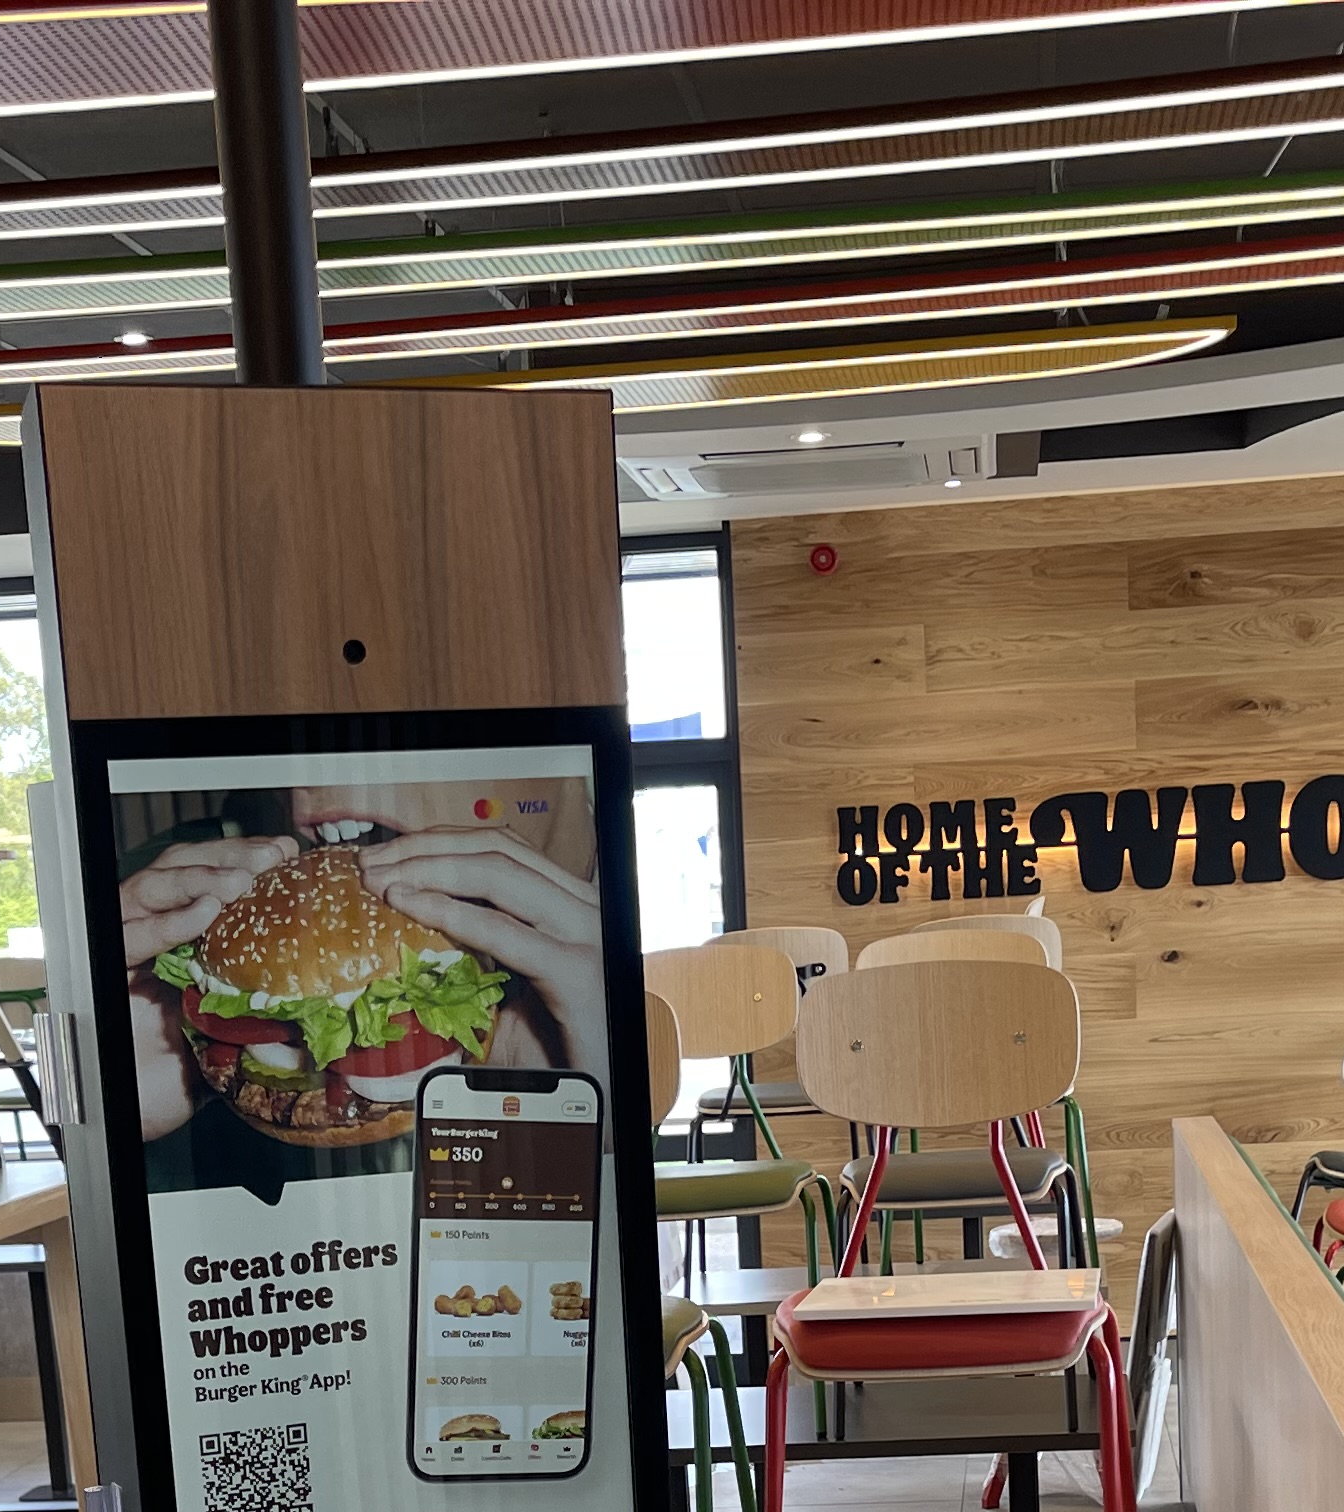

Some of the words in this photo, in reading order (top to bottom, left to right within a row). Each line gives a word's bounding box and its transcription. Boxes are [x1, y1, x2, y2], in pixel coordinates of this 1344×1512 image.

[516, 799, 549, 814] VISA
[837, 797, 1018, 859] HOME
[837, 852, 910, 906] OF
[920, 848, 1042, 901] THE
[452, 1146, 484, 1162] 350
[444, 1230, 460, 1239] 150
[462, 1230, 490, 1239] Points
[184, 1251, 285, 1285] Great
[290, 1239, 398, 1275] offers
[187, 1286, 254, 1322] and
[258, 1282, 334, 1314] free
[189, 1318, 368, 1358] Whoppers
[193, 1366, 217, 1380] on
[219, 1360, 250, 1378] the
[194, 1383, 258, 1403] Burger
[309, 1369, 352, 1391] App!
[440, 1376, 458, 1385] 300
[460, 1376, 487, 1385] Points
